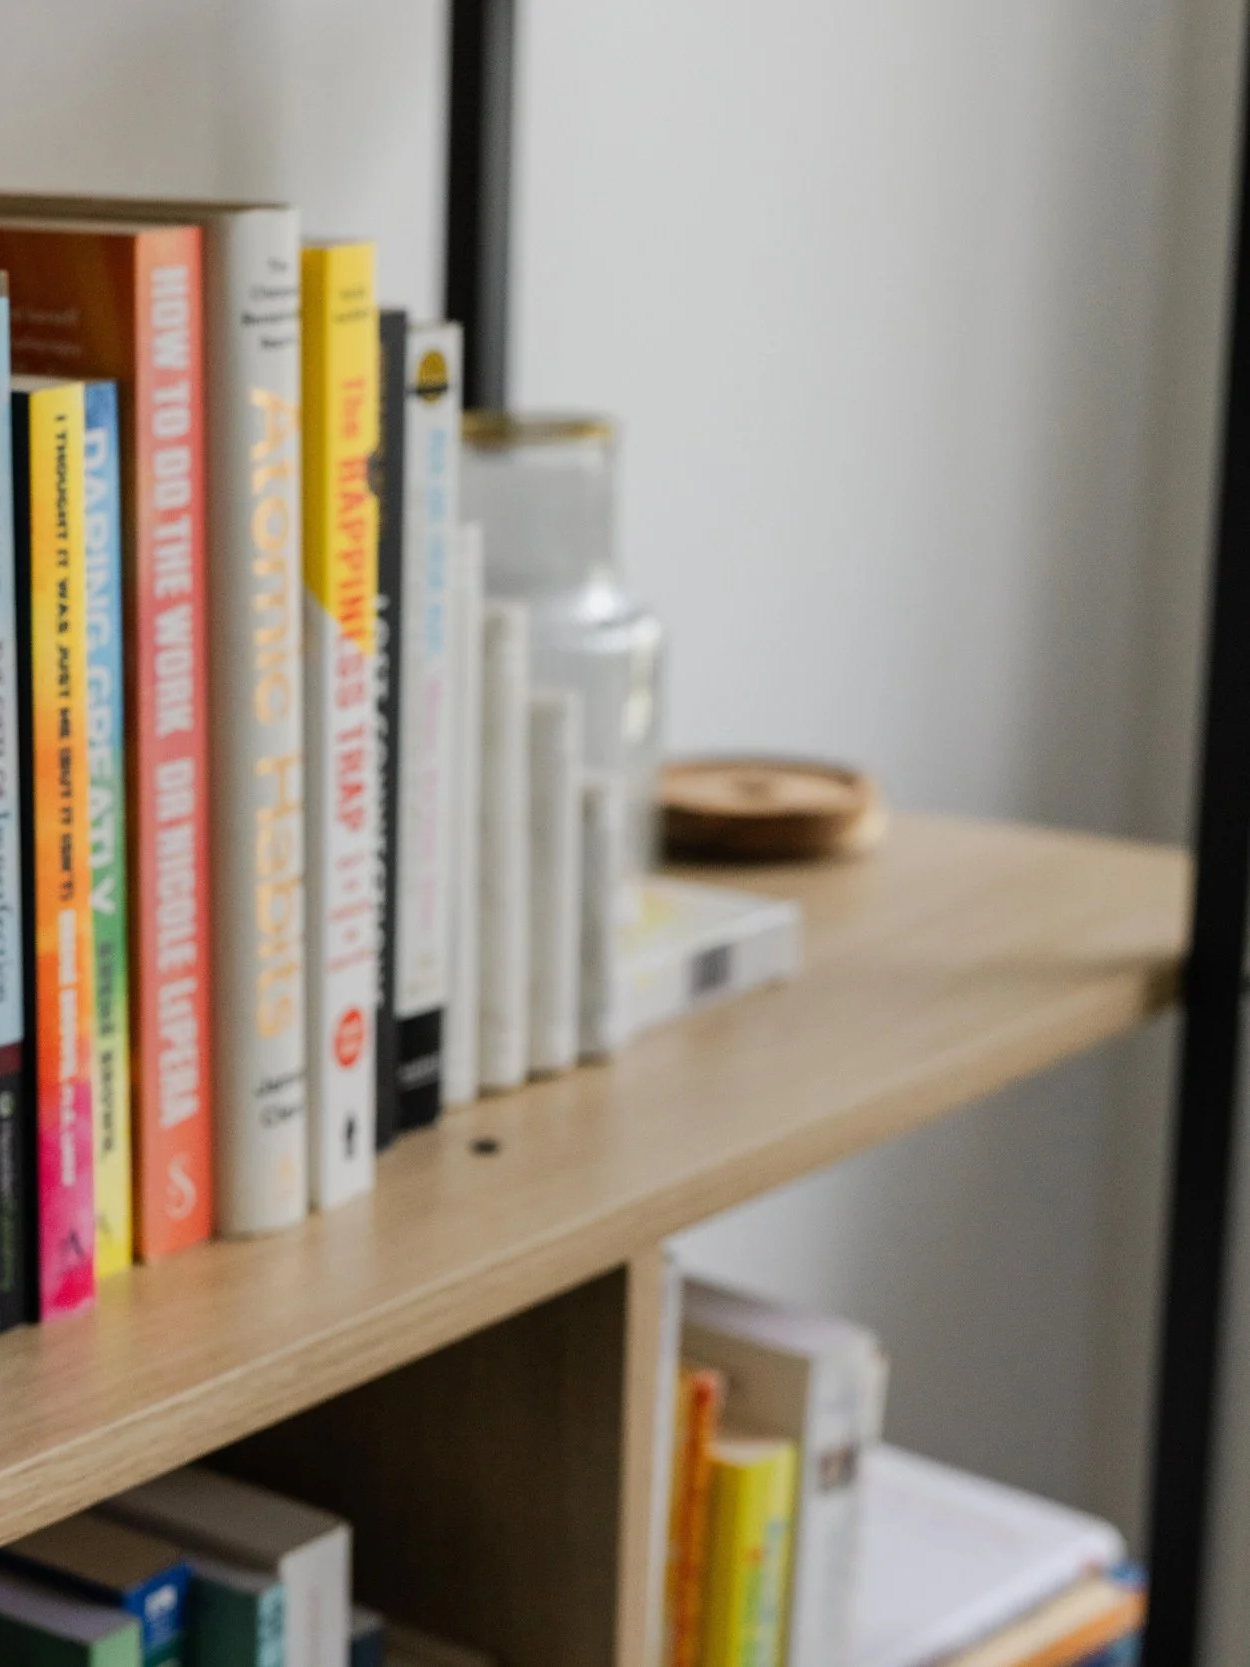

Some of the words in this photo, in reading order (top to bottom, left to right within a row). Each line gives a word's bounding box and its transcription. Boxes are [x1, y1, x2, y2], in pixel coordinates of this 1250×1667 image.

[152, 269, 188, 370] HOW
[153, 382, 190, 438] TO
[55, 428, 69, 541] THOUGHT
[153, 448, 191, 507] DO
[56, 548, 69, 567] IT
[84, 427, 109, 649] DARING
[152, 515, 193, 599] THE
[56, 578, 69, 635] WAS
[57, 643, 70, 698] JUST
[155, 606, 194, 737] WORK
[57, 706, 71, 744] ME
[58, 804, 71, 827] IT
[87, 663, 115, 916] GREATLY
[336, 722, 366, 832] TRAP
[157, 827, 196, 971] NICOLE
